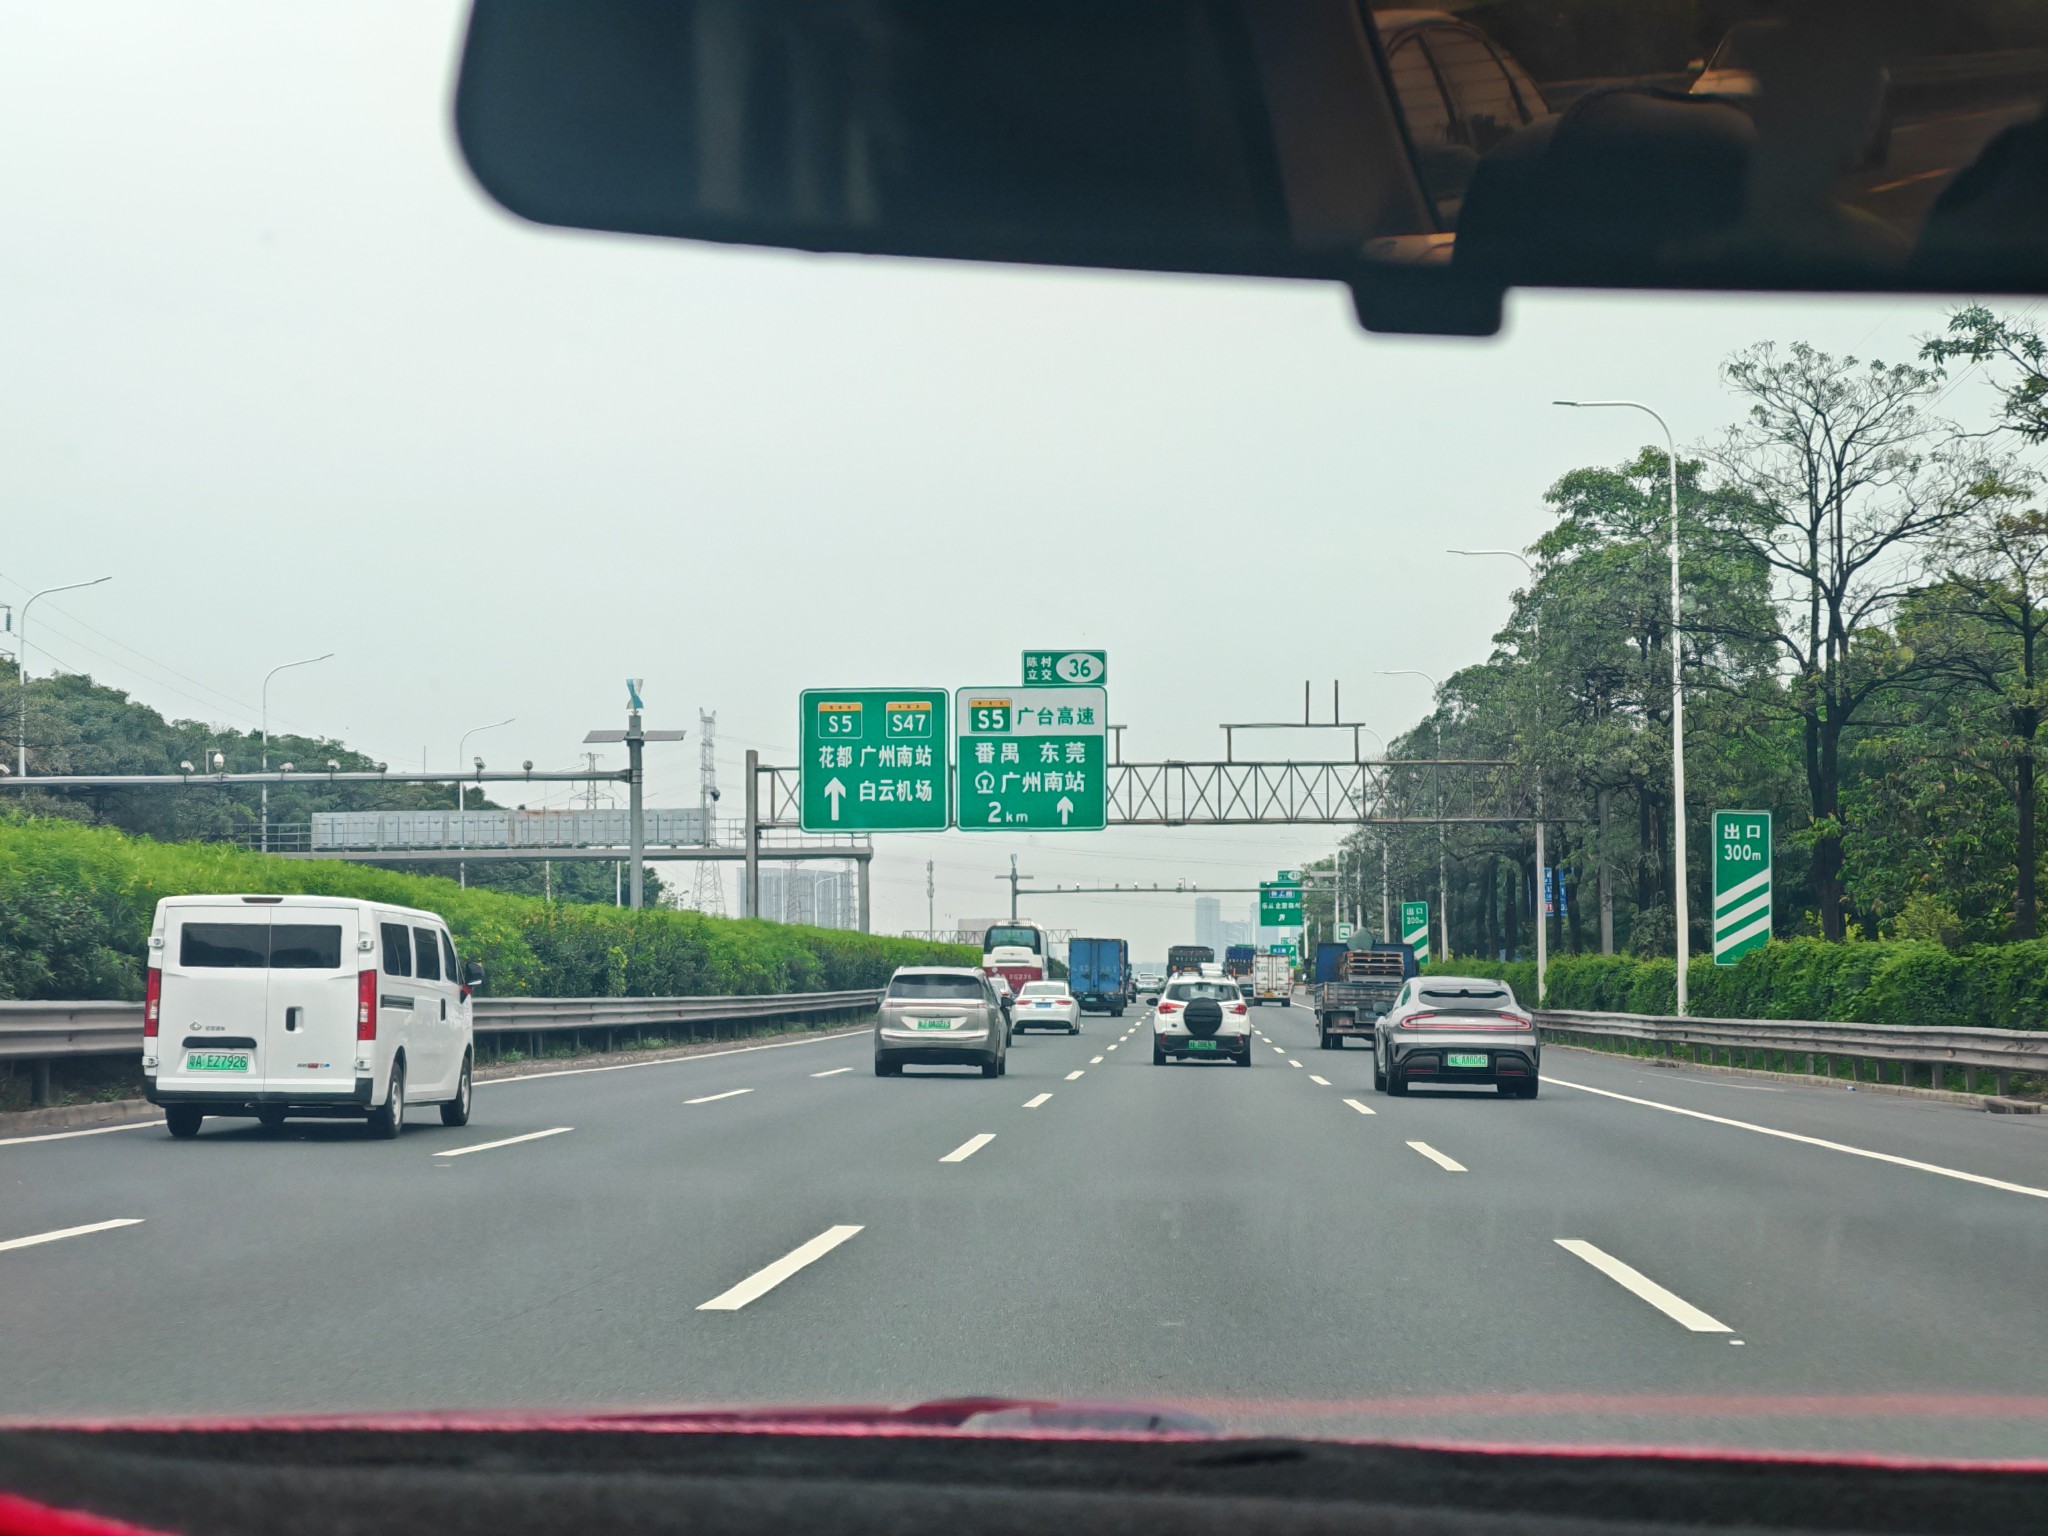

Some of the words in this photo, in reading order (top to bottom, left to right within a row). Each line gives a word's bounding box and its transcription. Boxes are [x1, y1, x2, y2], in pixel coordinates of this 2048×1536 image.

[1026, 655, 1053, 668] 陈村
[1068, 658, 1092, 678] 36
[1026, 669, 1053, 681] 立交
[828, 715, 853, 733] S5
[892, 714, 926, 733] S47
[977, 709, 1004, 730] S5
[1017, 706, 1095, 726] 广台高速
[818, 745, 853, 768] 花都
[859, 745, 933, 768] 广州南站
[974, 743, 1020, 764] 番禺
[1038, 742, 1086, 764] 东莞
[858, 779, 933, 803] 白云机场
[1001, 771, 1086, 793] 广州南站
[1724, 823, 1761, 840] 出口
[1724, 844, 1762, 861] 300m
